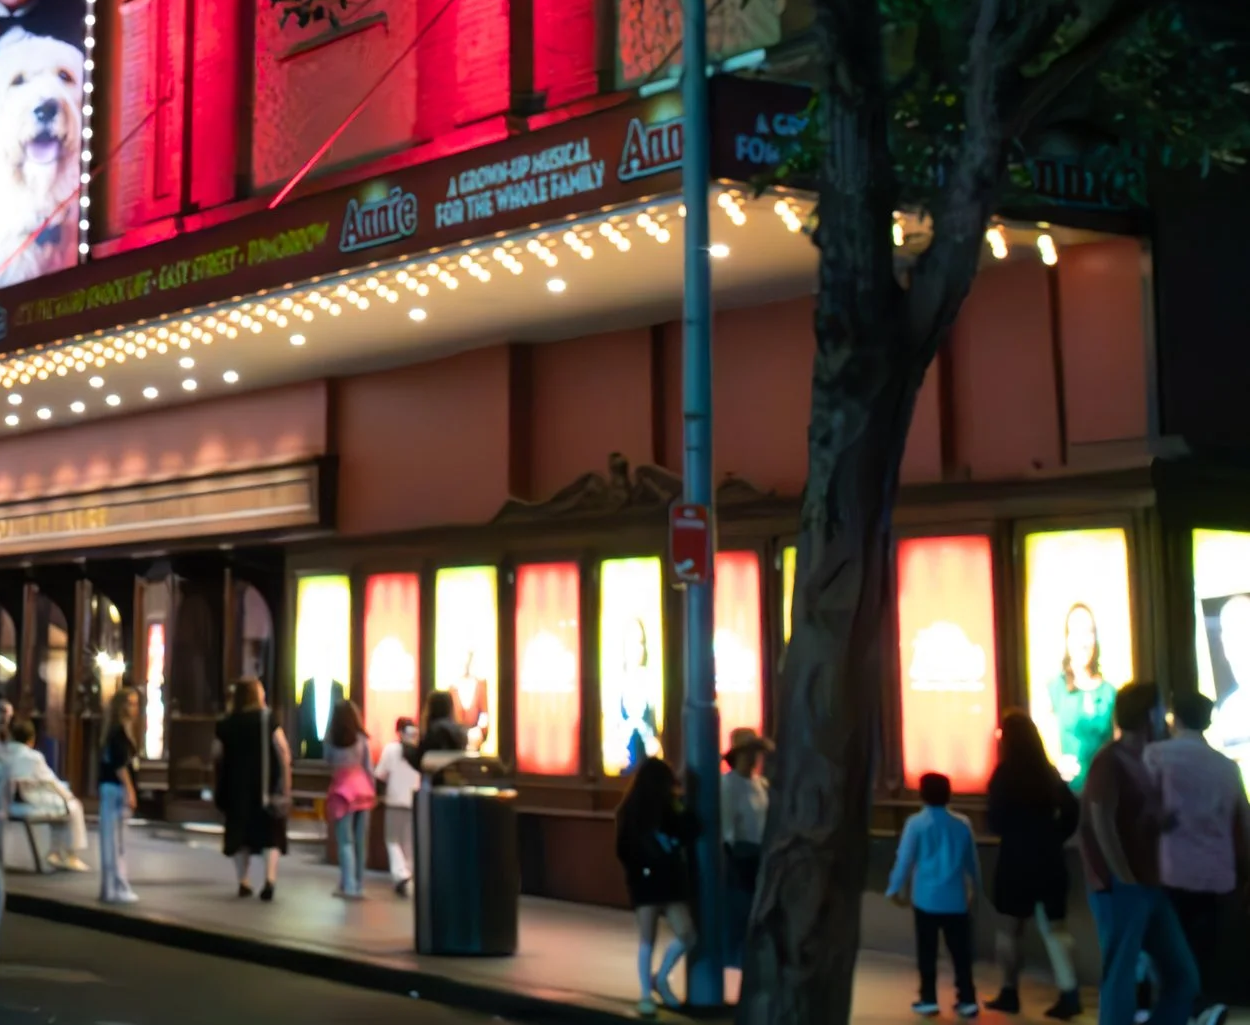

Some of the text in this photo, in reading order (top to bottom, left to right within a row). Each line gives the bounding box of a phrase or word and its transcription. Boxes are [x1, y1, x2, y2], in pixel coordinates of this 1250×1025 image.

[446, 137, 592, 198] A GROWN-UP MUSICAL
[618, 117, 683, 181] Ann
[434, 160, 606, 229] FOR THE WHOLE FAMILY
